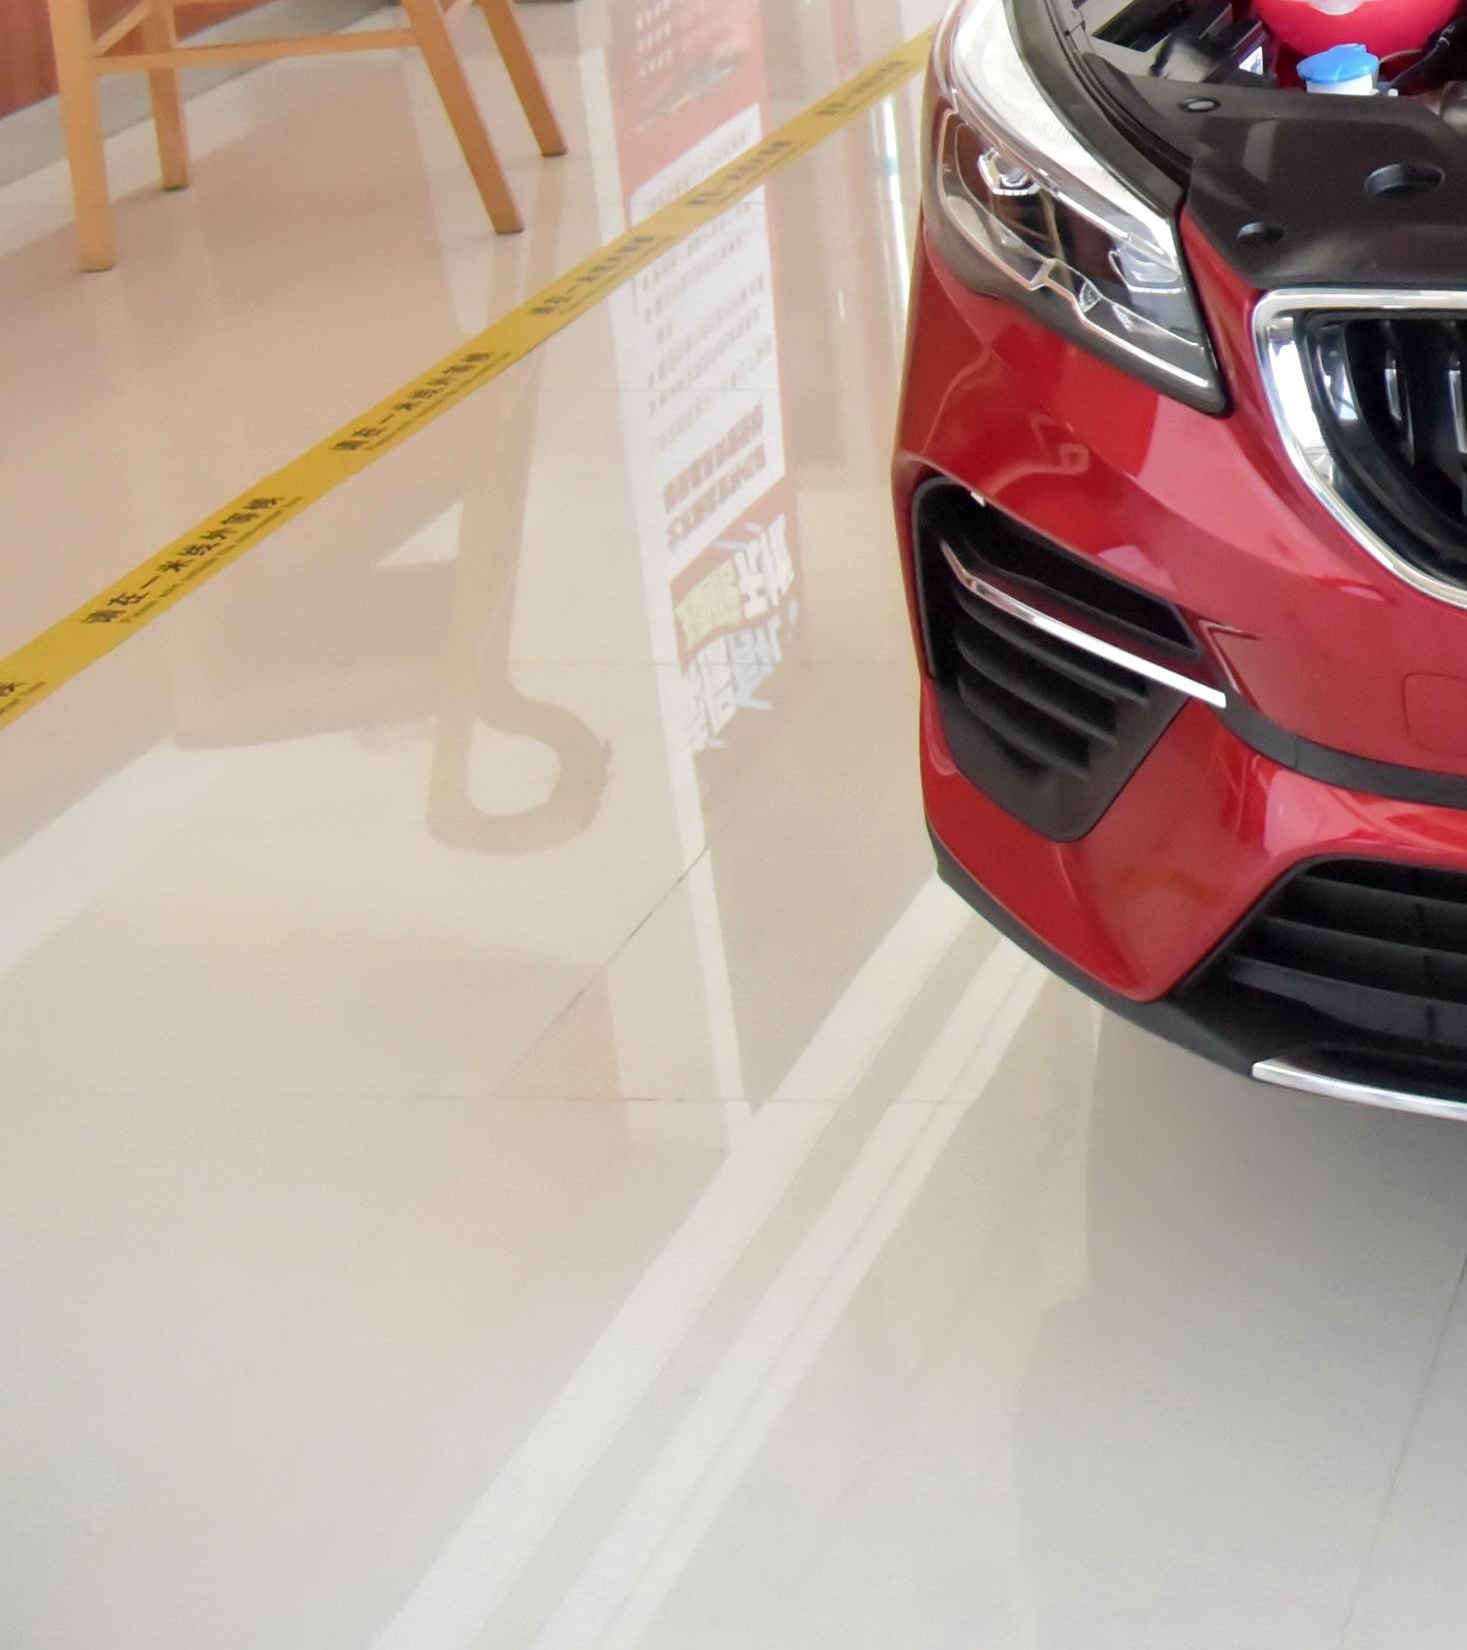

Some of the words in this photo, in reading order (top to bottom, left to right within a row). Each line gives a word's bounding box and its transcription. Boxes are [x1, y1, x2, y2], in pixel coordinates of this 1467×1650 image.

[80, 496, 285, 623] 请在一米线外等候
